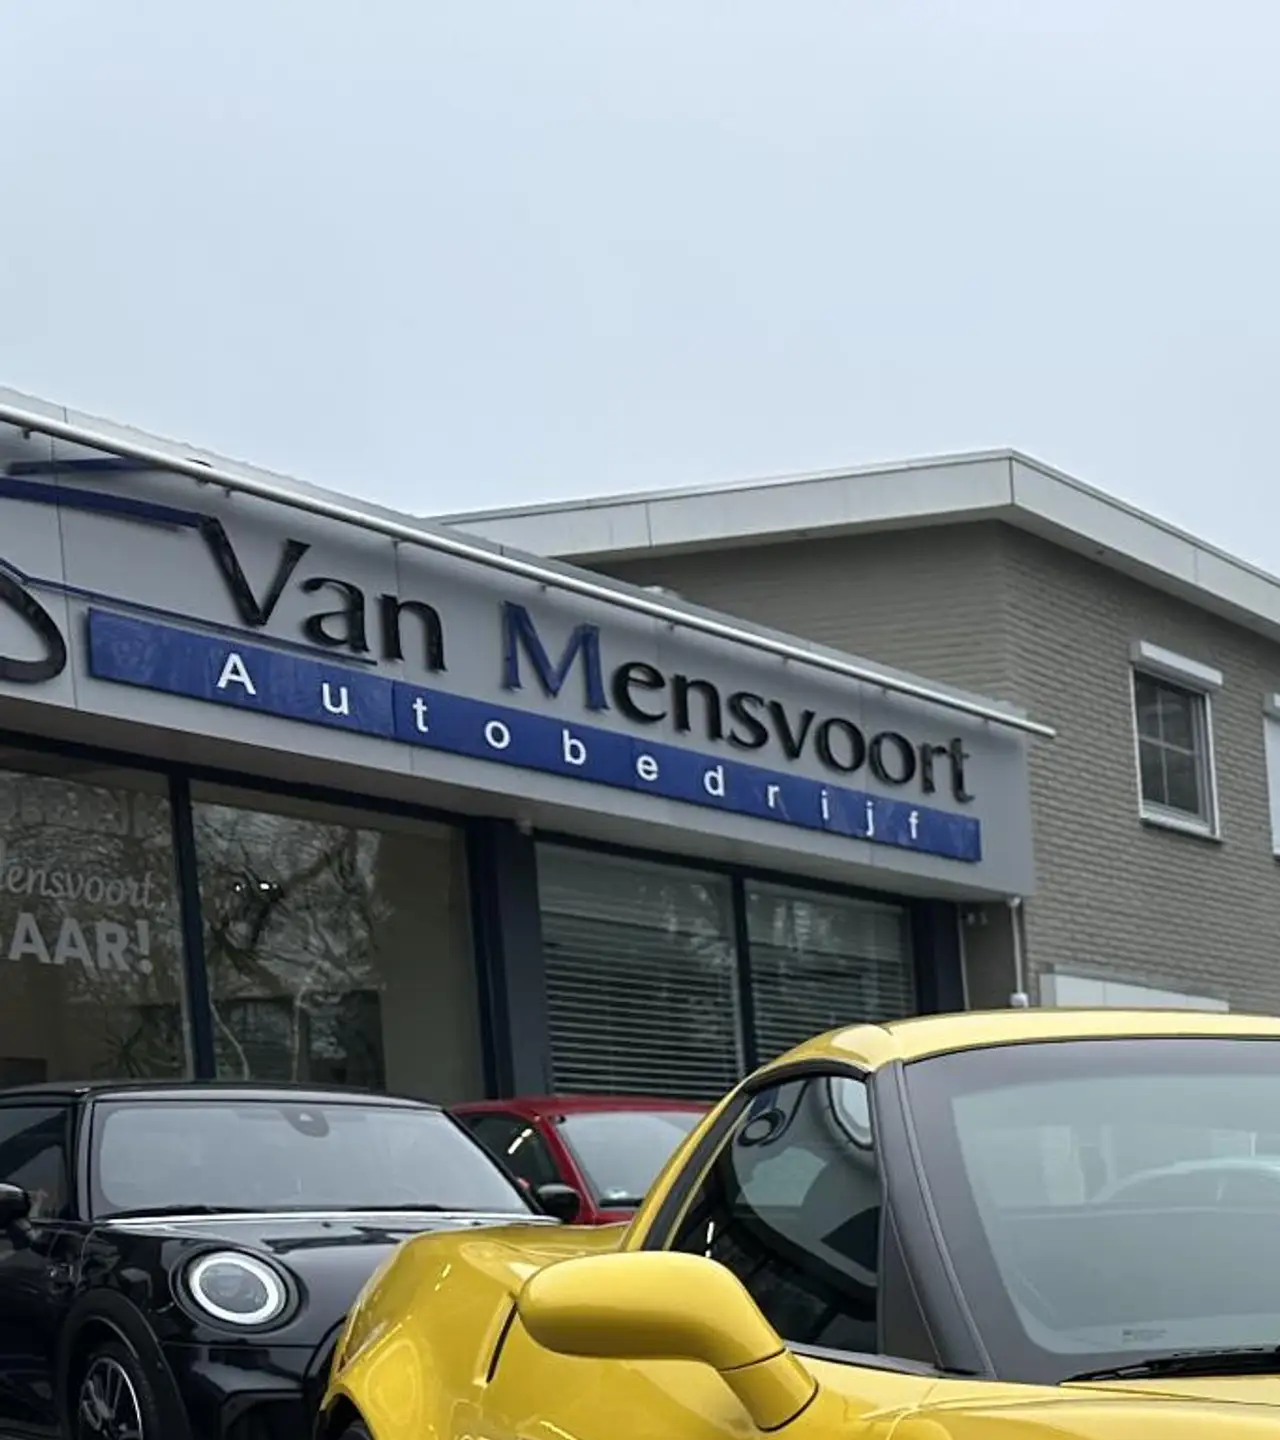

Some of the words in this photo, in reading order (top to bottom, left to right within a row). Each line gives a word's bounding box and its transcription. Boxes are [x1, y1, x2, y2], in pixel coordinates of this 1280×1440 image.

[200, 514, 448, 672] Van
[502, 600, 976, 803] Mensvoort
[216, 652, 920, 840] Autobedrijf
[0, 858, 155, 908] ensvoort
